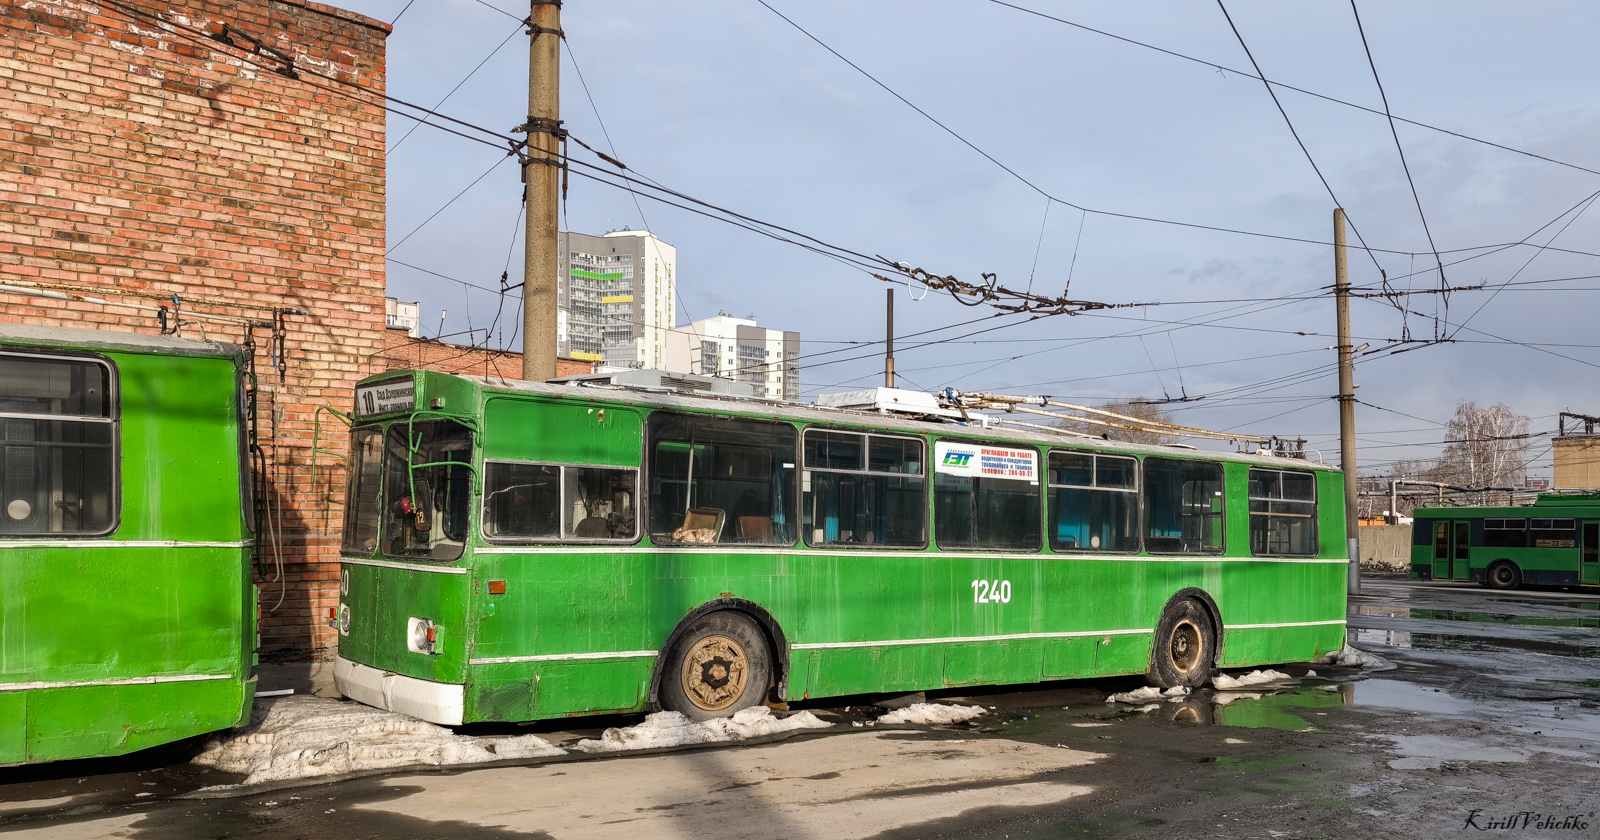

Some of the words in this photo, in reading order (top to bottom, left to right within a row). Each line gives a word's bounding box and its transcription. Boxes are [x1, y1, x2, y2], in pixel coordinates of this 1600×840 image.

[363, 391, 374, 414] 10
[981, 449, 1009, 457] ПРИГЛАШАЕМ
[1017, 451, 1032, 459] РАБОТУ
[416, 511, 425, 524] 12
[971, 579, 1011, 604] 1240
